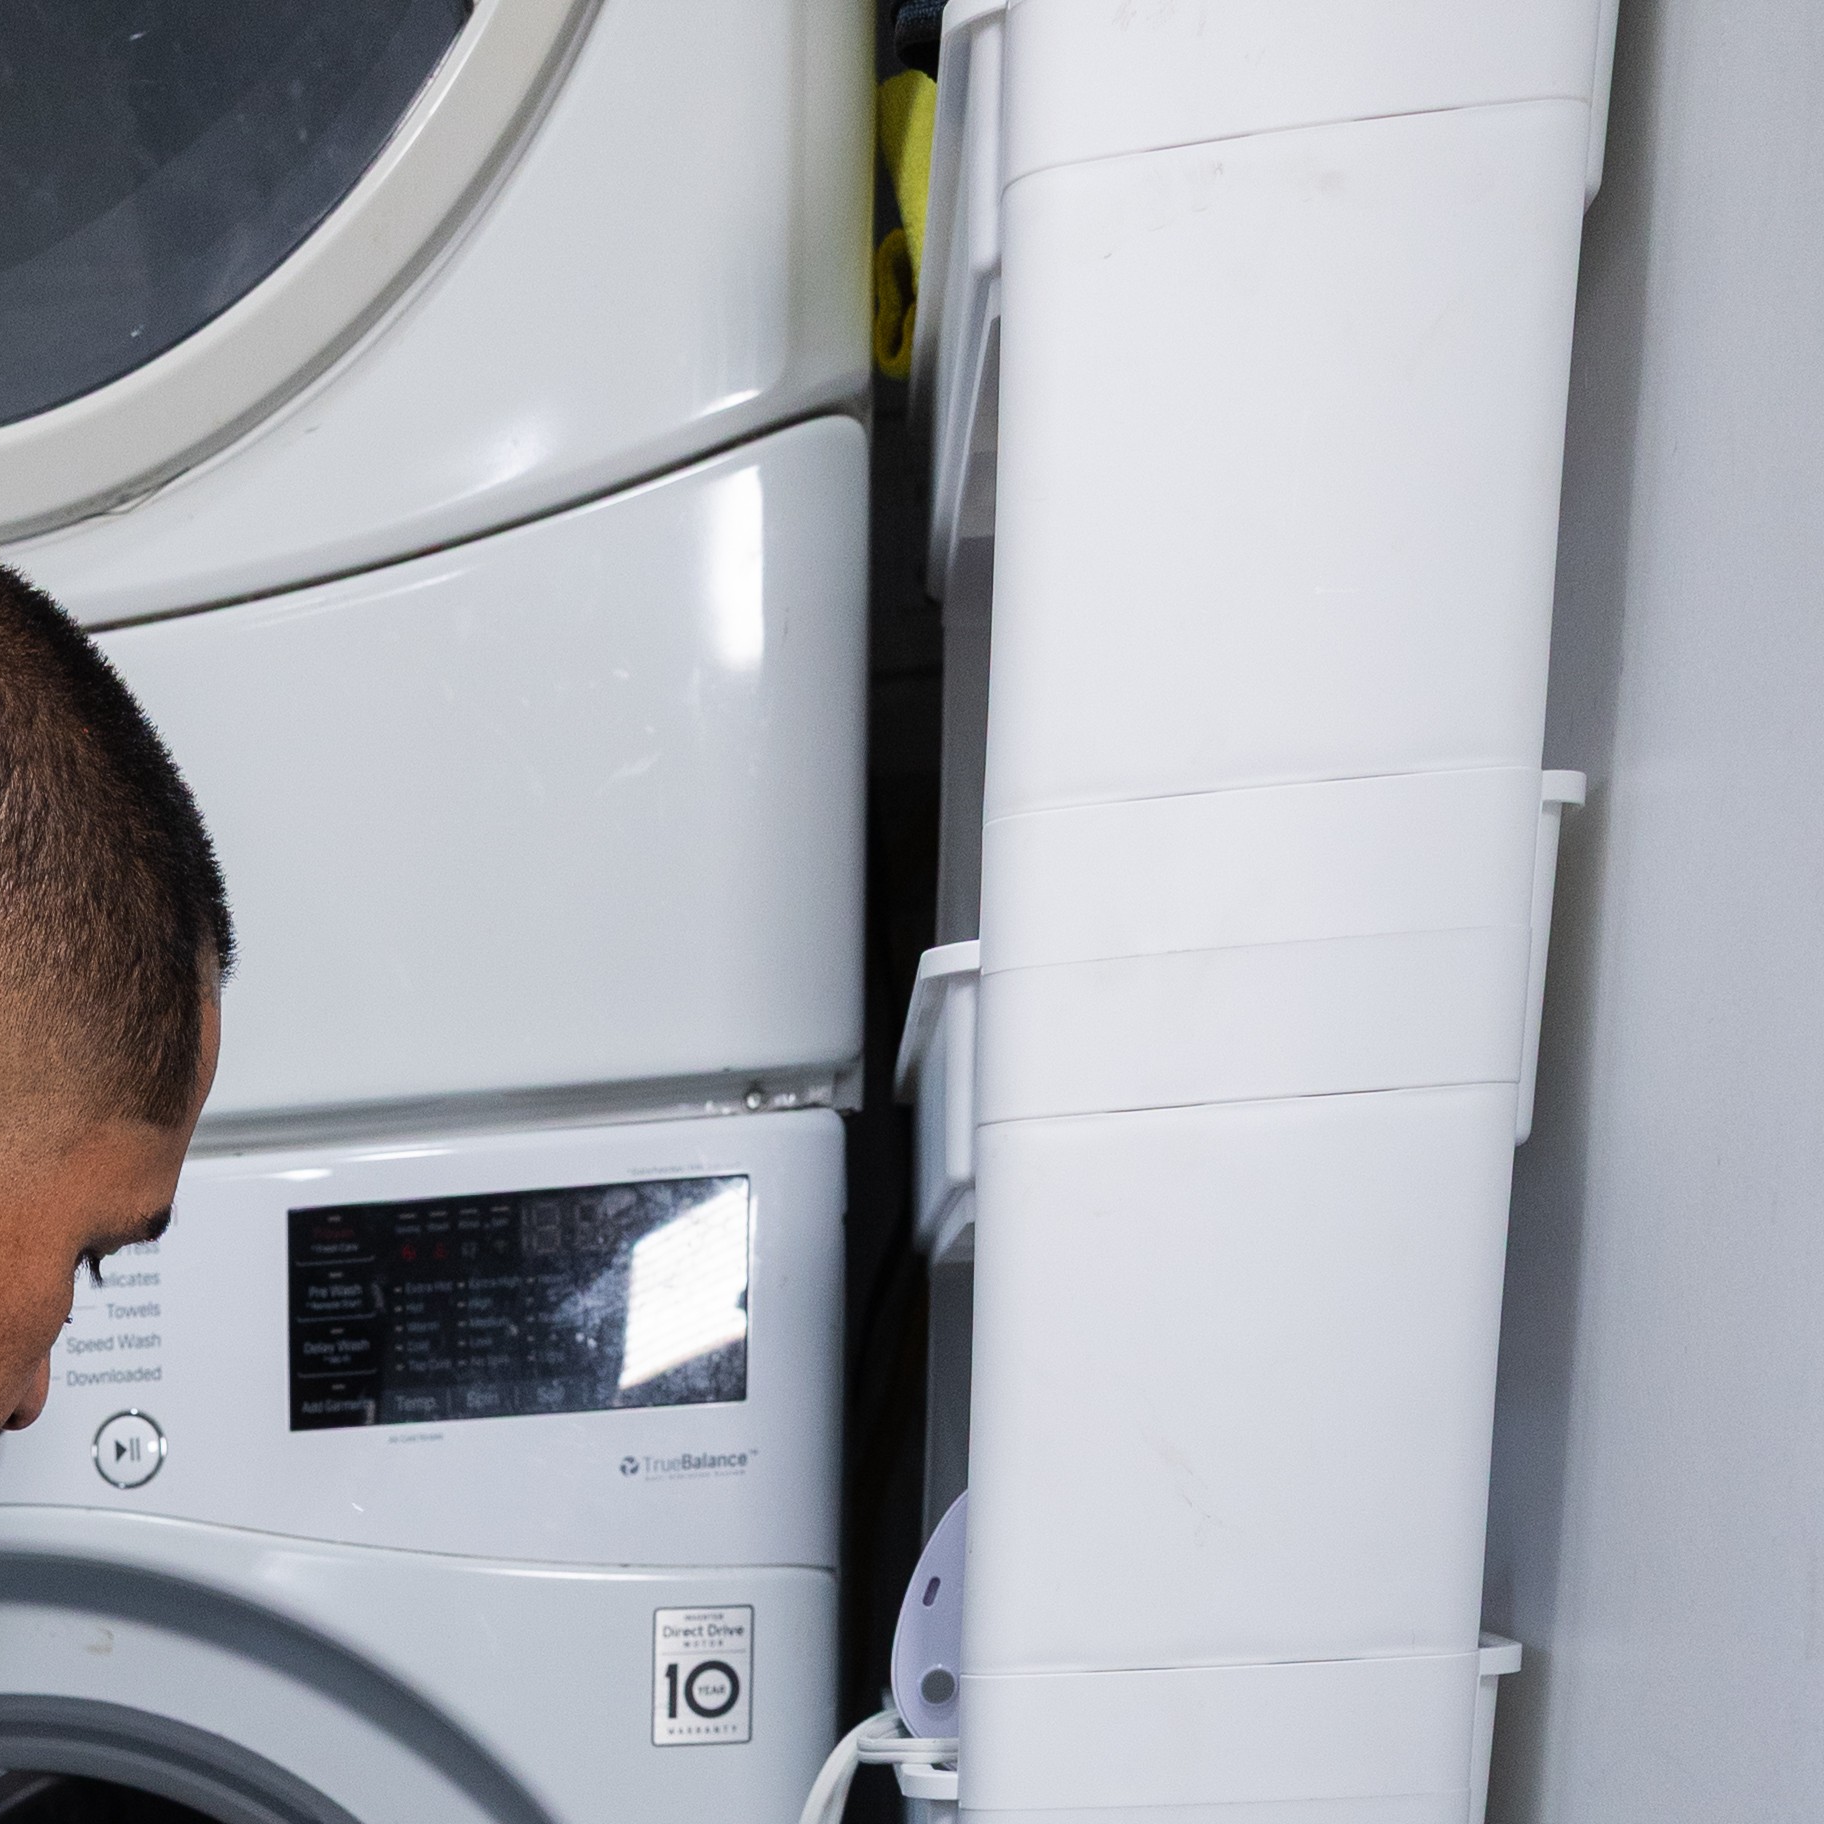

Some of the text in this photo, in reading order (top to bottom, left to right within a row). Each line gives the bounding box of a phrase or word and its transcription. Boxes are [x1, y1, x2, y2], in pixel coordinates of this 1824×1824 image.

[108, 1302, 161, 1319] Towels
[67, 1333, 161, 1354] Speed Wash
[67, 1367, 162, 1386] Downloaded
[663, 1624, 744, 1637] Direct Drive
[665, 1660, 740, 1719] 10
[698, 1685, 725, 1696] YEAR
